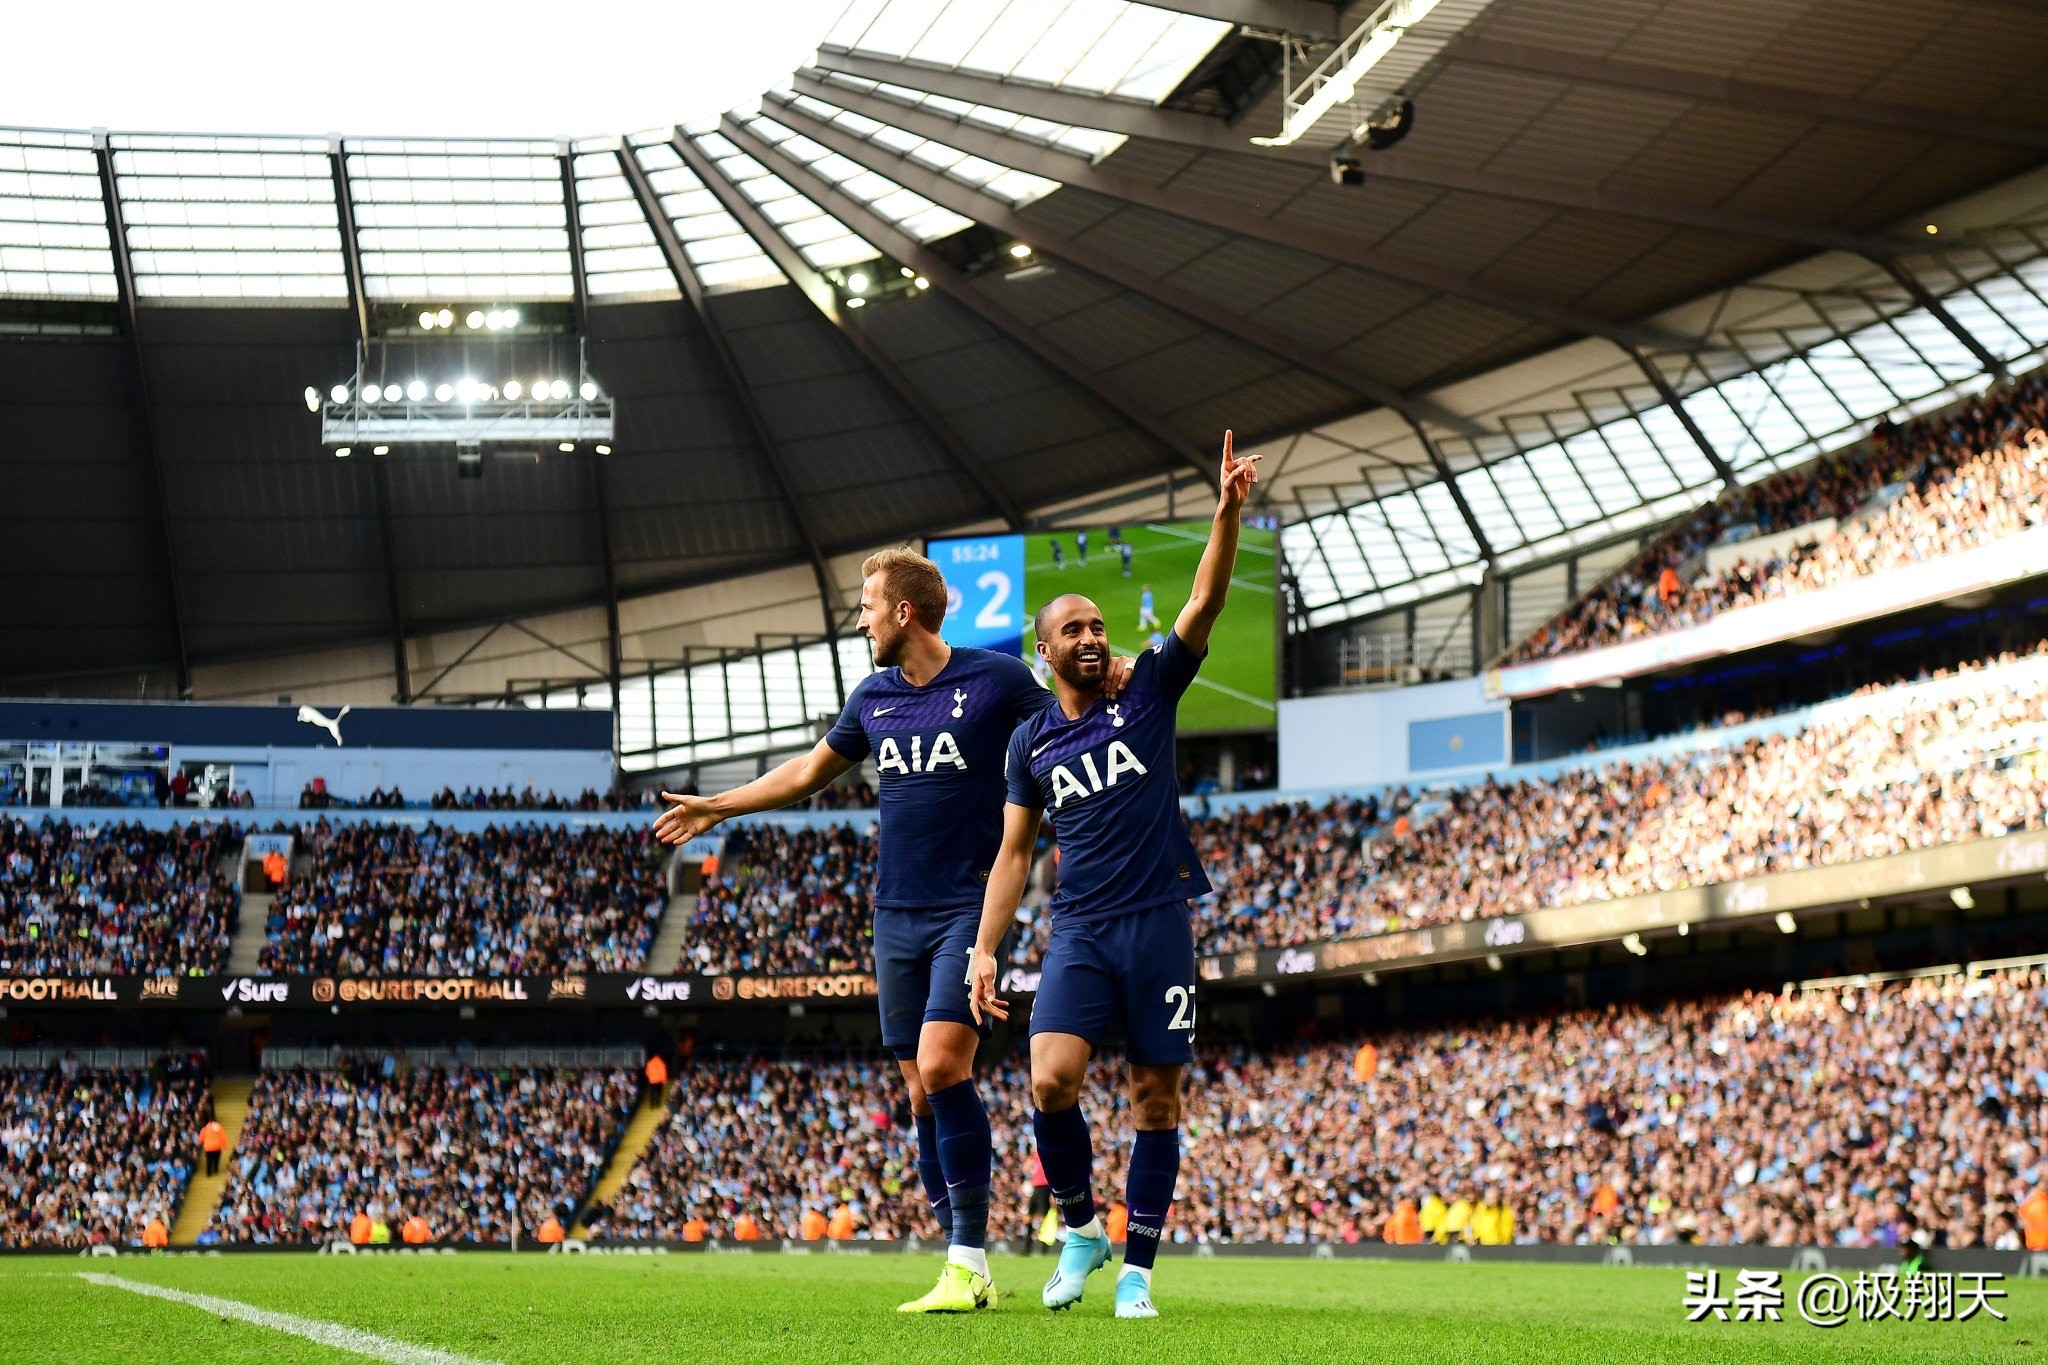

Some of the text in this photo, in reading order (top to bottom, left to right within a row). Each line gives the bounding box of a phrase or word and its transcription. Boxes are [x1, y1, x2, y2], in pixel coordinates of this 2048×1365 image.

[952, 544, 999, 563] 55:24
[975, 570, 1011, 629] 2
[877, 732, 968, 775] AIA
[1052, 740, 1148, 809] AIA
[0, 978, 118, 1000] FOOTBALL
[238, 977, 288, 1001] Sure
[338, 978, 529, 1001] @SUREFOOTBALL
[641, 977, 691, 1000] Sure
[1127, 1221, 1160, 1239] SPURS
